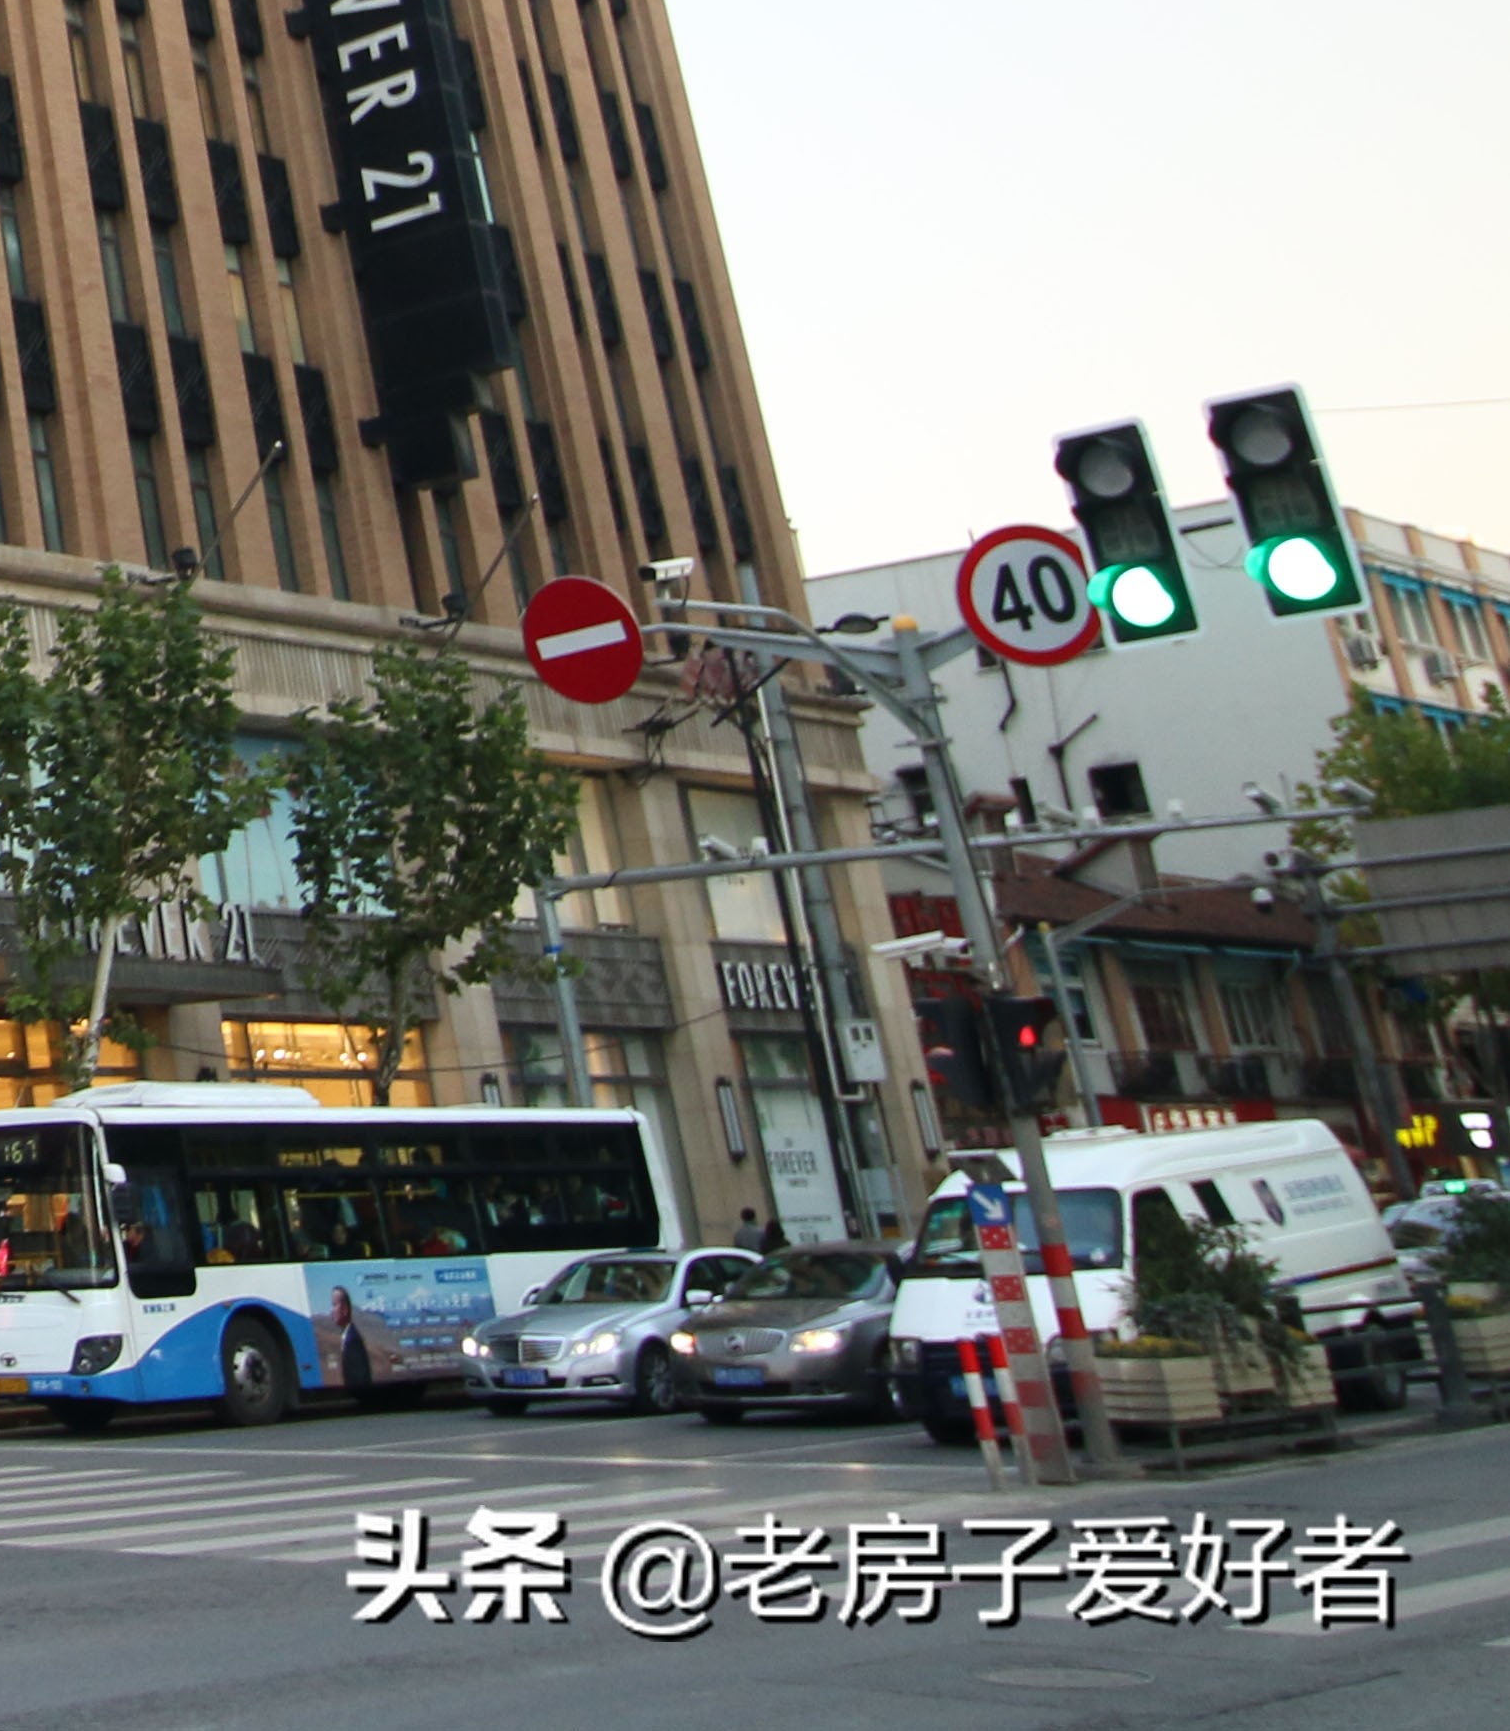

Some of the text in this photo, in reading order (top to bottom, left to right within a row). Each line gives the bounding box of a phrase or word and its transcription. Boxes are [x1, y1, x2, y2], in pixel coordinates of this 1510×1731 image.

[360, 150, 443, 232] 21
[990, 553, 1078, 632] 40
[37, 896, 258, 963] EVER 21
[721, 960, 817, 1011] FOREV
